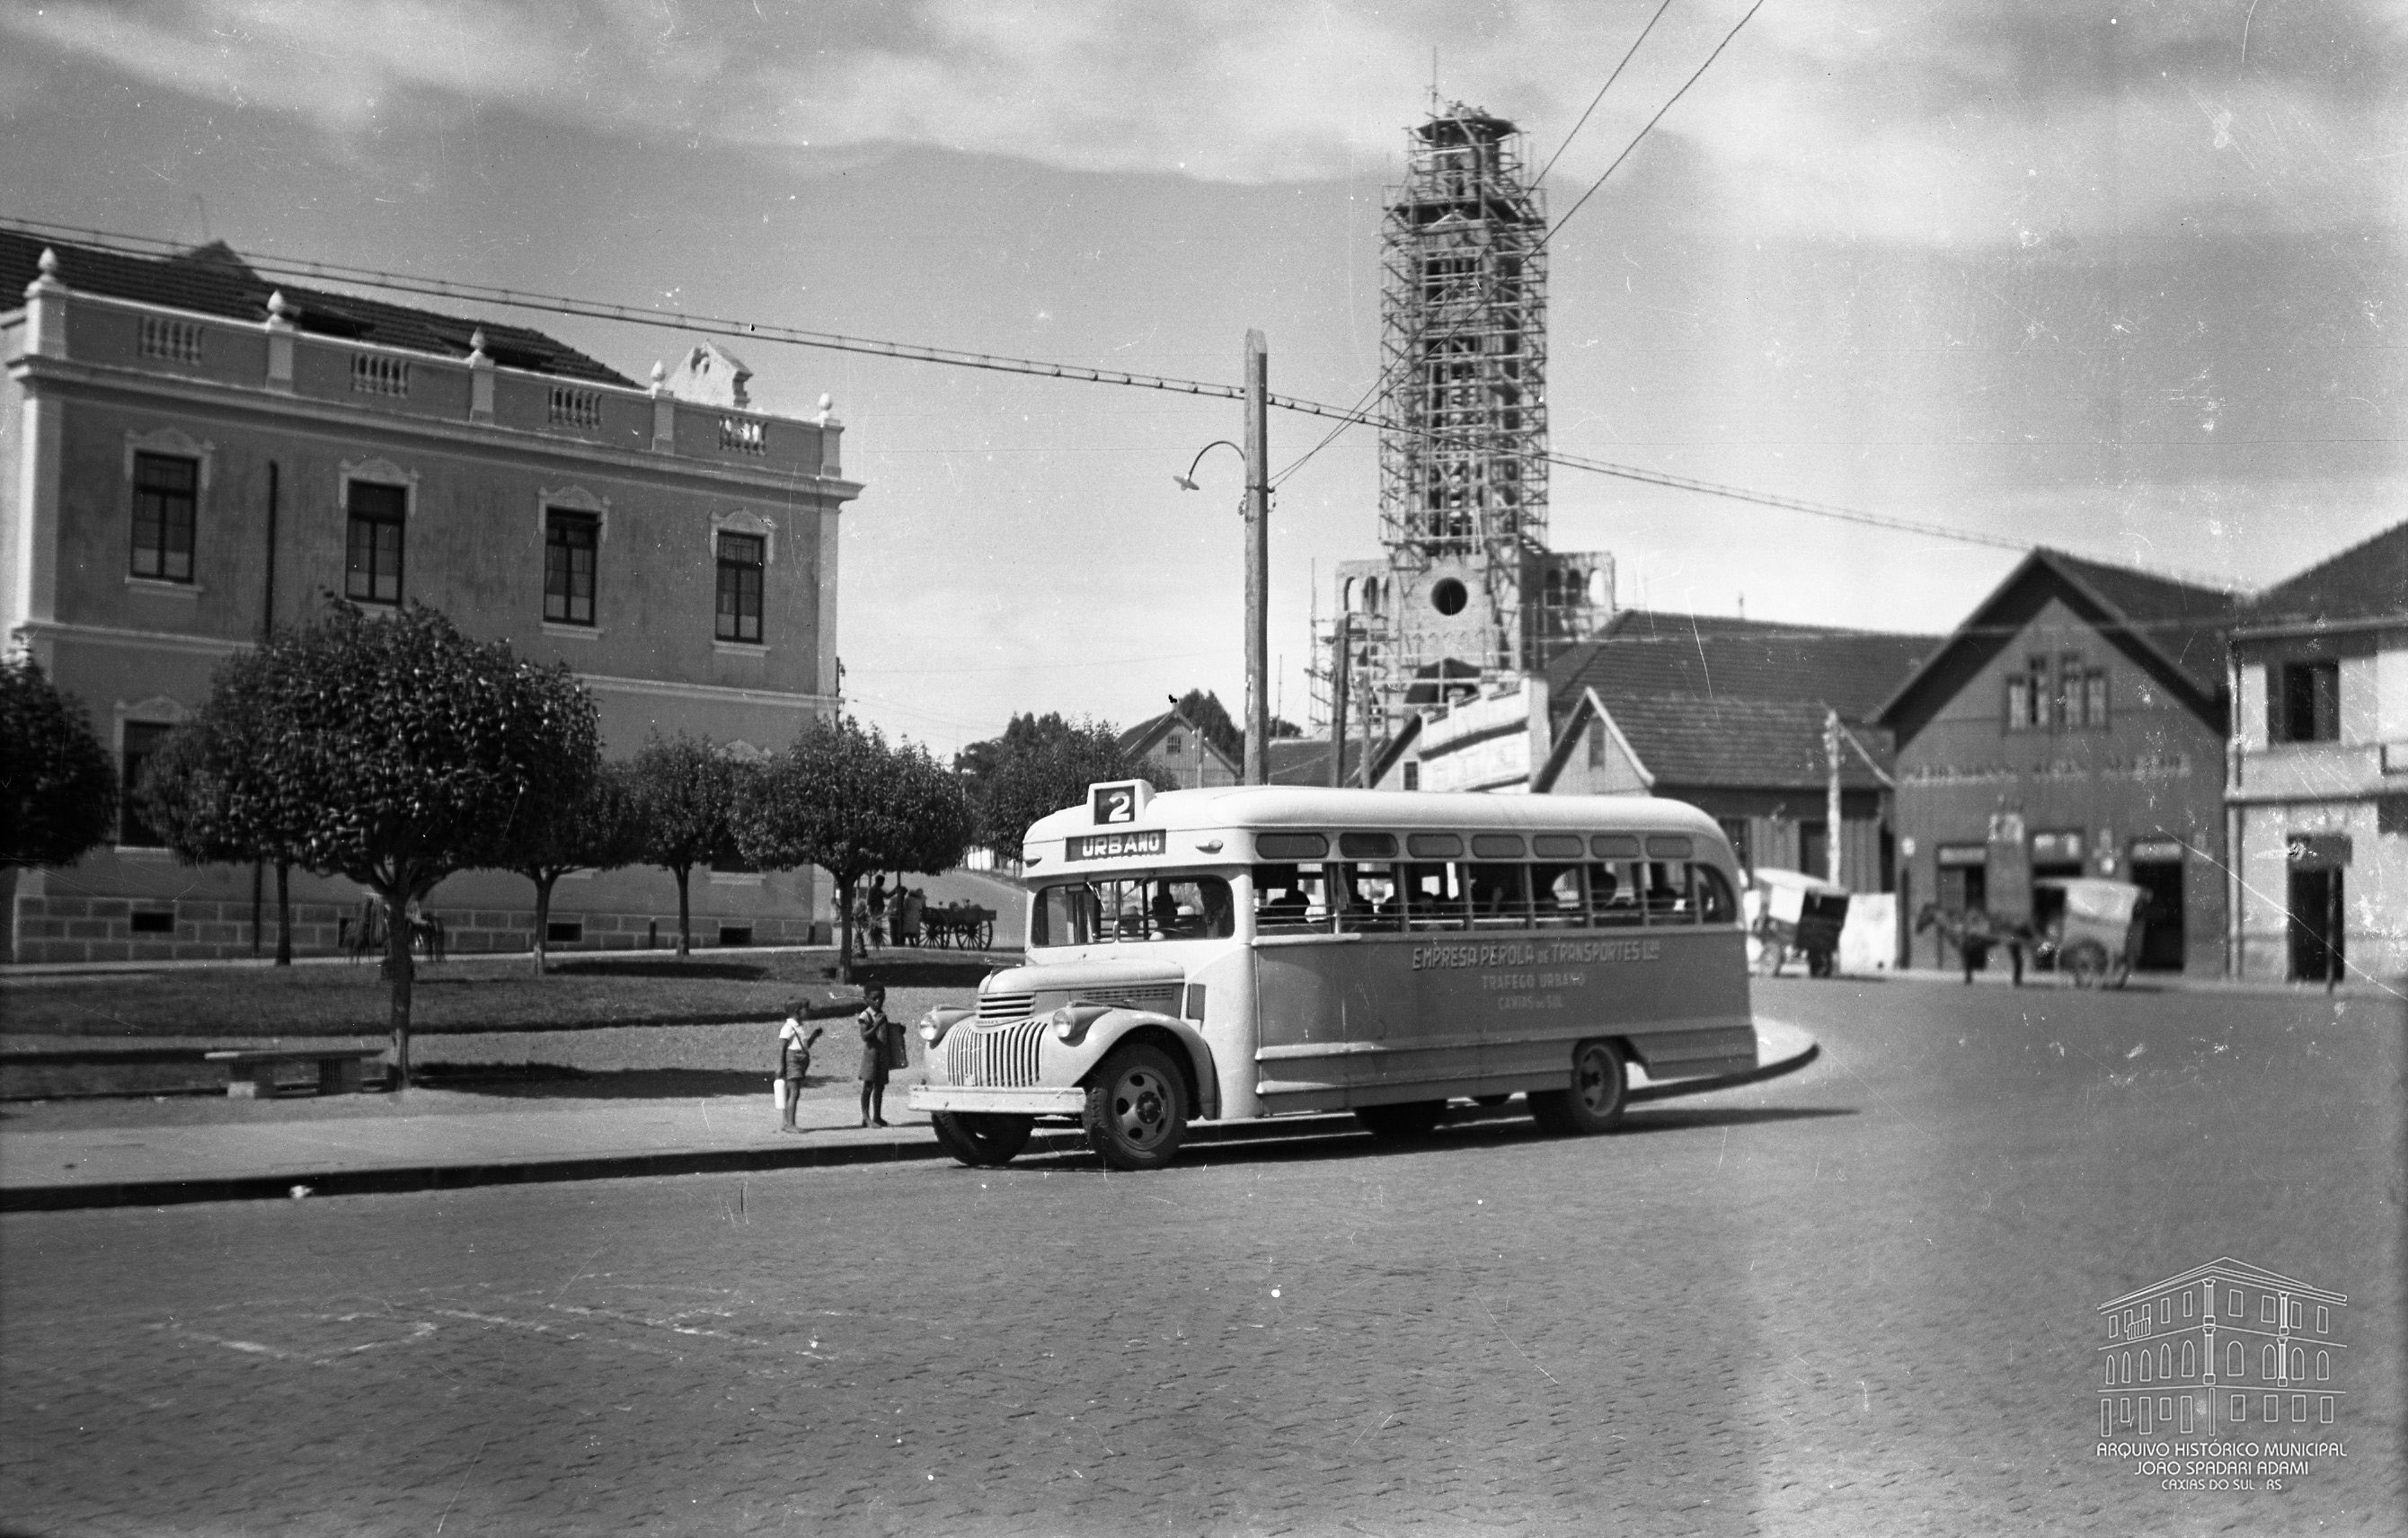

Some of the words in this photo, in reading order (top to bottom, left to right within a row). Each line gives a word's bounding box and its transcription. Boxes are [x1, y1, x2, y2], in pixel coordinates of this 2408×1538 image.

[1109, 791, 1130, 822] 2
[1082, 833, 1160, 858] URBANO
[1412, 946, 1478, 969] EMPRESA
[1550, 941, 1640, 962] TRANSPORTES
